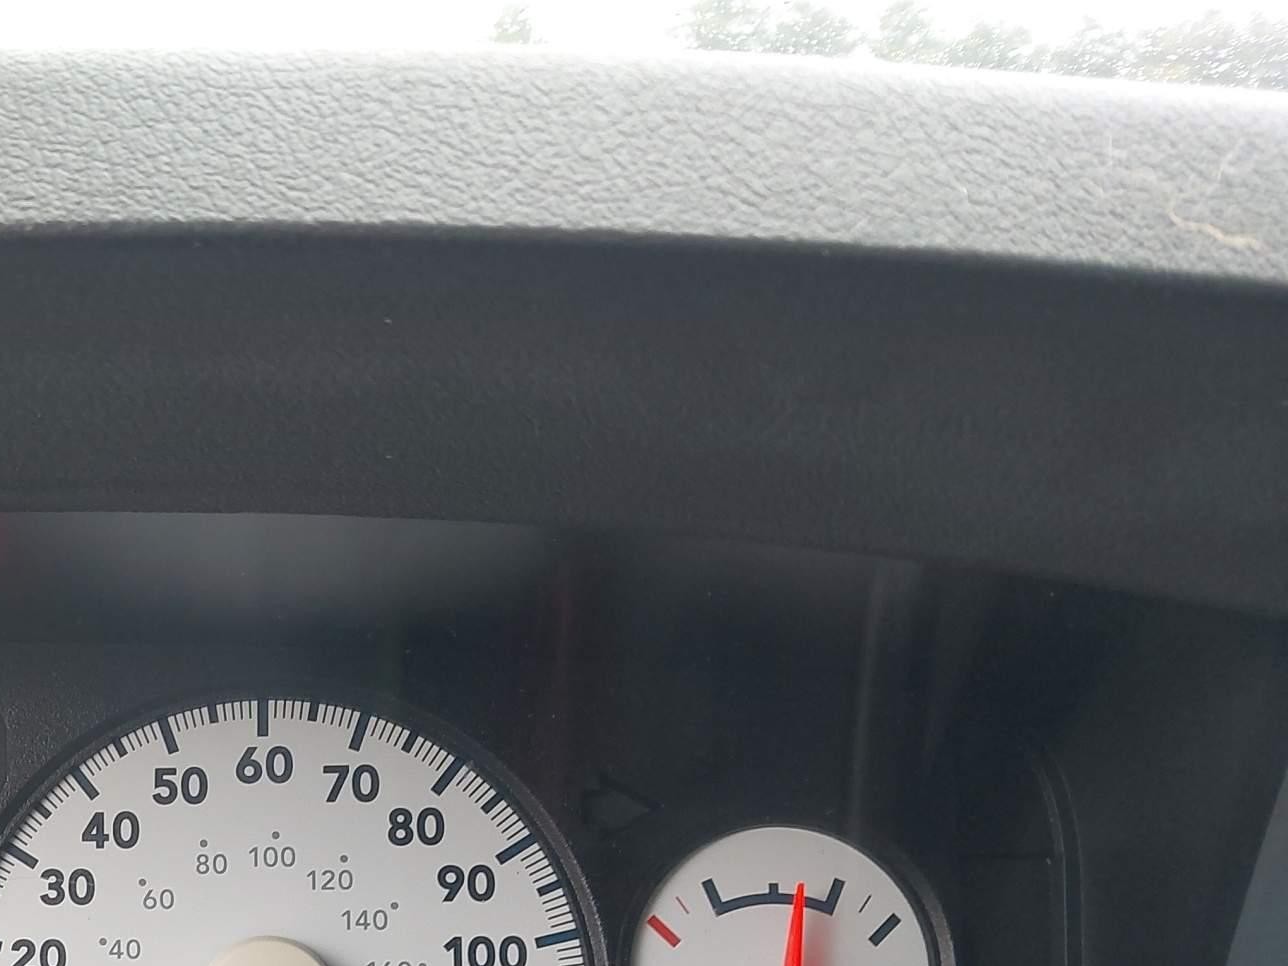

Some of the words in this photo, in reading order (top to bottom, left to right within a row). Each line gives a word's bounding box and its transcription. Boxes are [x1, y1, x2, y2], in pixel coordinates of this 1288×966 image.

[236, 746, 293, 784] 60
[323, 764, 379, 802] 70
[153, 767, 208, 805] 50
[82, 811, 139, 849] 40
[388, 807, 444, 846] 80
[197, 854, 227, 874] 80
[249, 847, 295, 867] 100
[40, 869, 95, 905] 30
[307, 870, 353, 890] 120
[437, 865, 495, 902] 90
[143, 889, 174, 909] 60
[342, 910, 387, 930] 140
[109, 939, 140, 959] 40
